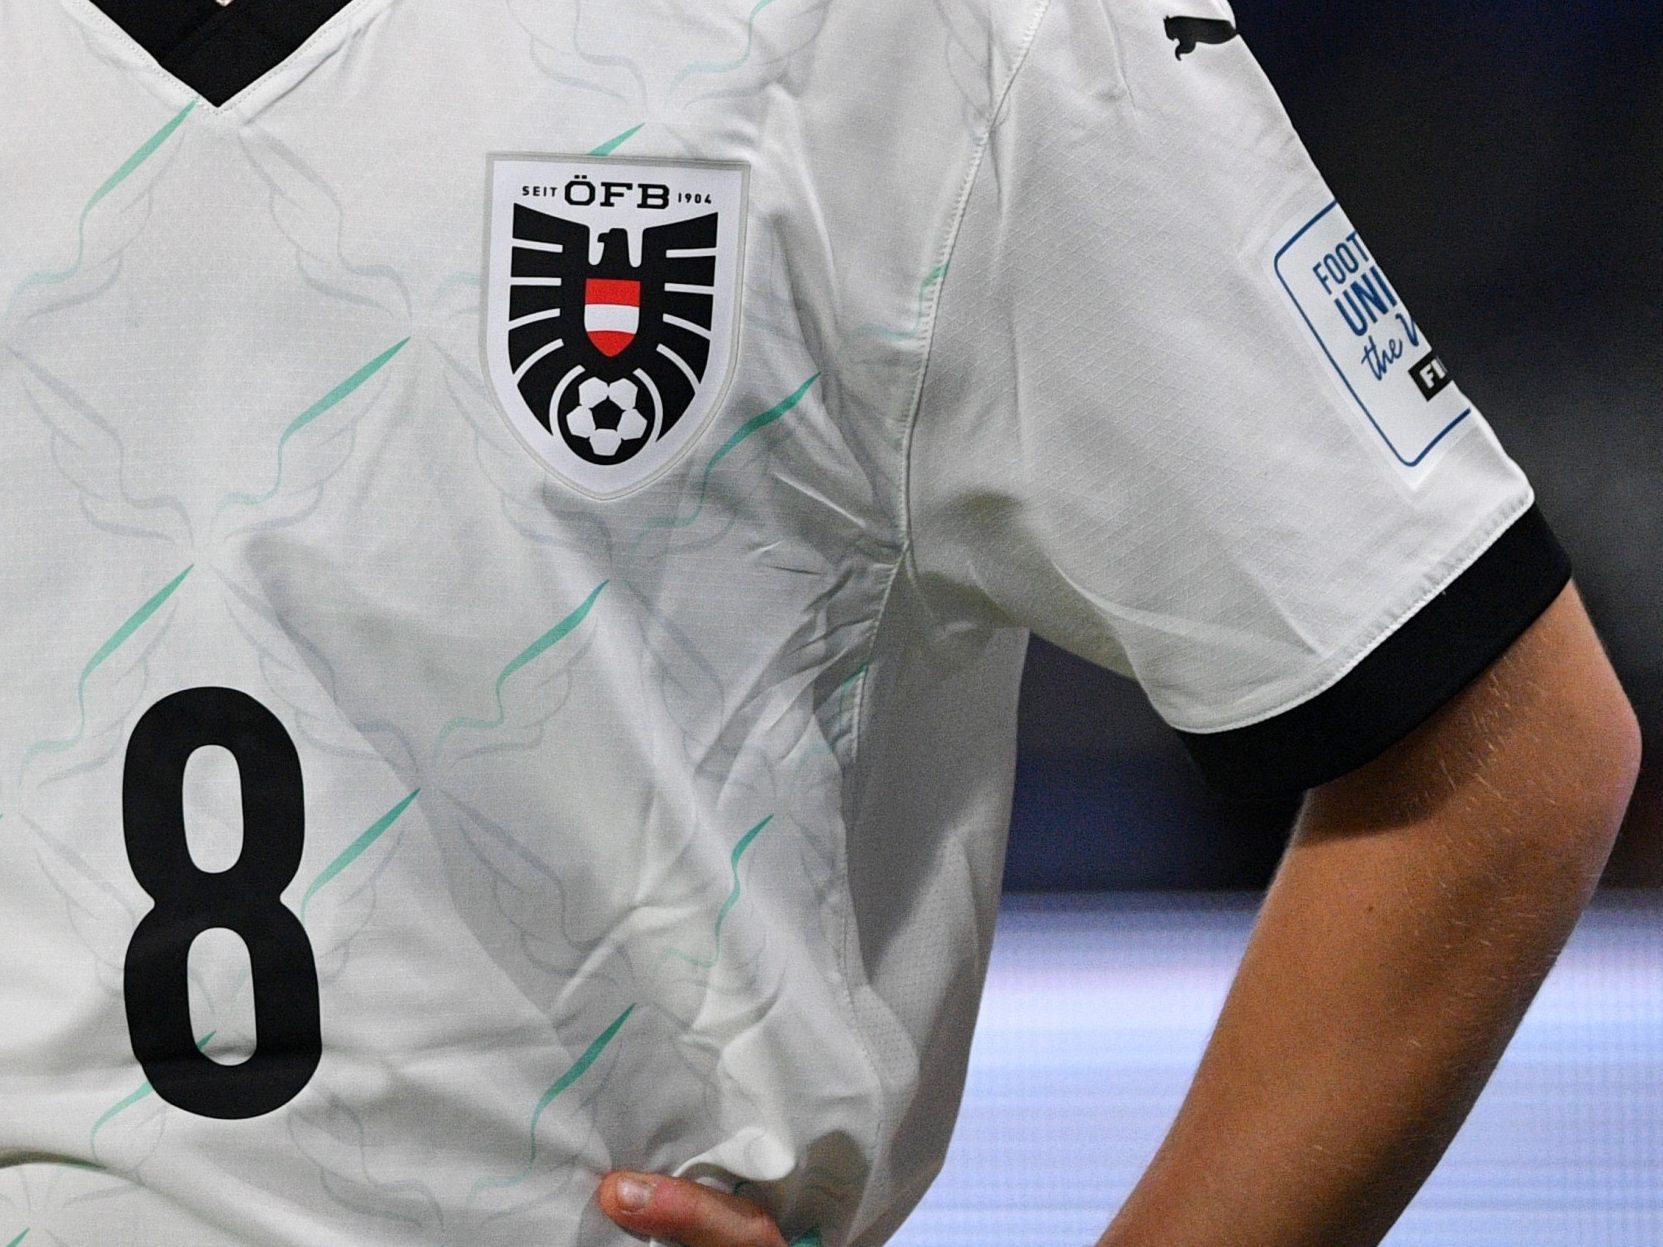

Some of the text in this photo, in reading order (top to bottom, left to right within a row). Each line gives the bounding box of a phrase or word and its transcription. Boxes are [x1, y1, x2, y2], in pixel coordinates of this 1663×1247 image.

[521, 174, 713, 210] SEIT ÖFB 1904
[1312, 231, 1370, 296] FOOT
[1333, 265, 1398, 337] UNI
[1360, 335, 1403, 382] the
[122, 685, 323, 1121] 8
